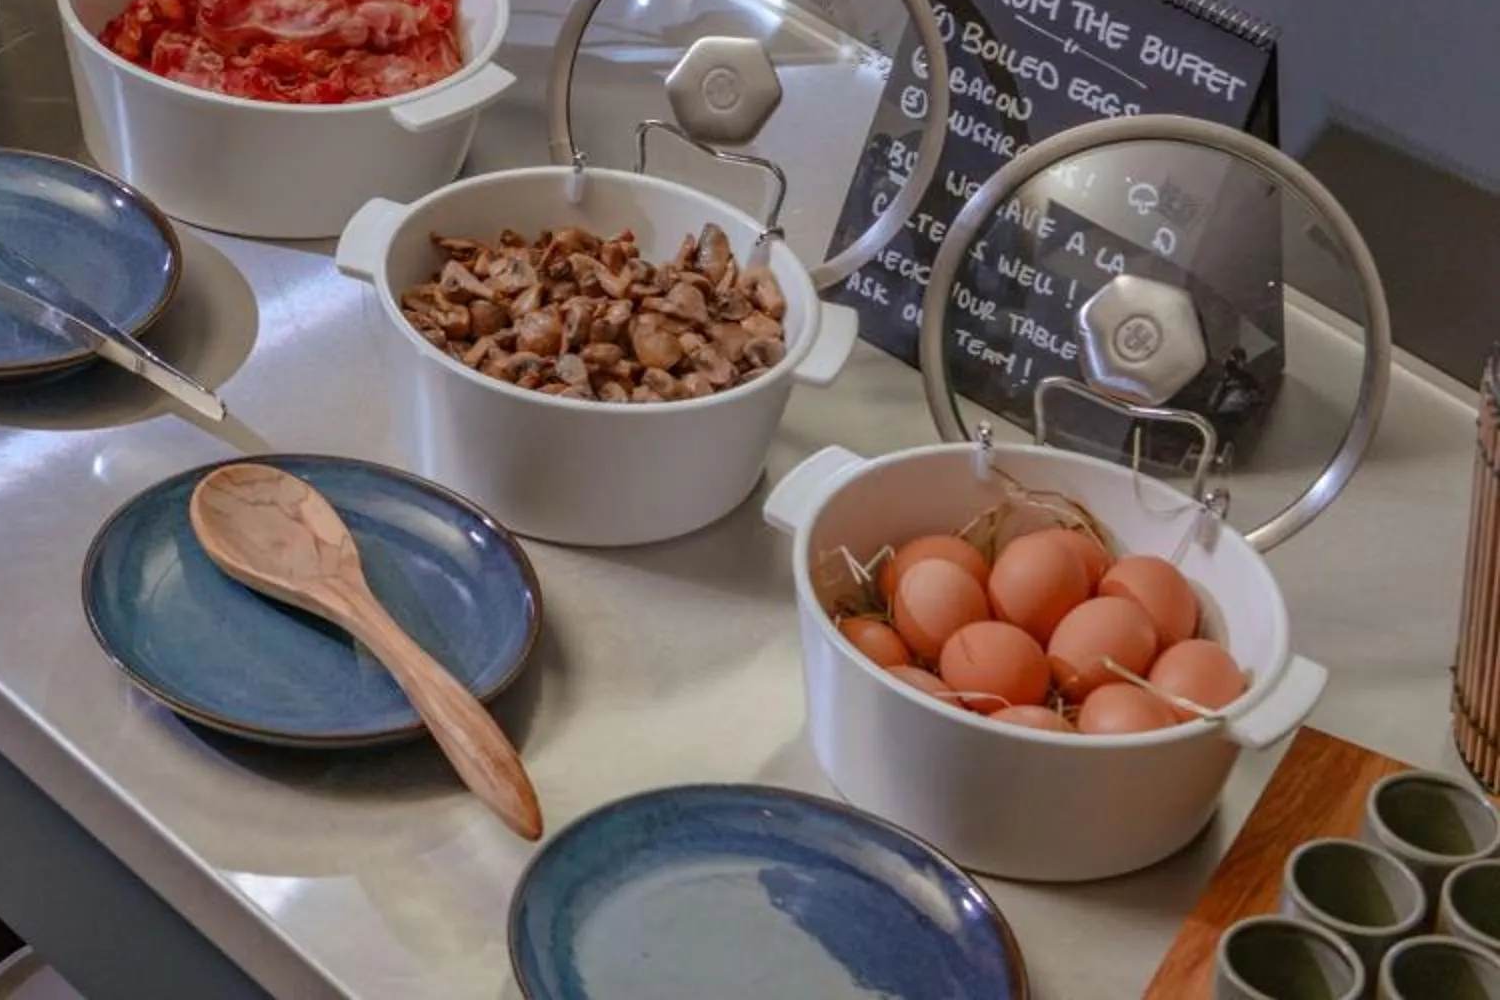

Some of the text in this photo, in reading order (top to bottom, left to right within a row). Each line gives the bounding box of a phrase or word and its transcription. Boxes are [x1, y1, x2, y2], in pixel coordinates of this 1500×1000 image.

[1071, 0, 1131, 50] THE
[1139, 34, 1247, 102] BUFFET
[948, 66, 1033, 121] BACON
[996, 198, 1057, 239] AVE
[1065, 231, 1085, 256] A
[1093, 246, 1125, 274] LA
[845, 270, 890, 306] ASK
[996, 253, 1054, 296] WELL
[1008, 312, 1079, 361] TABLE
